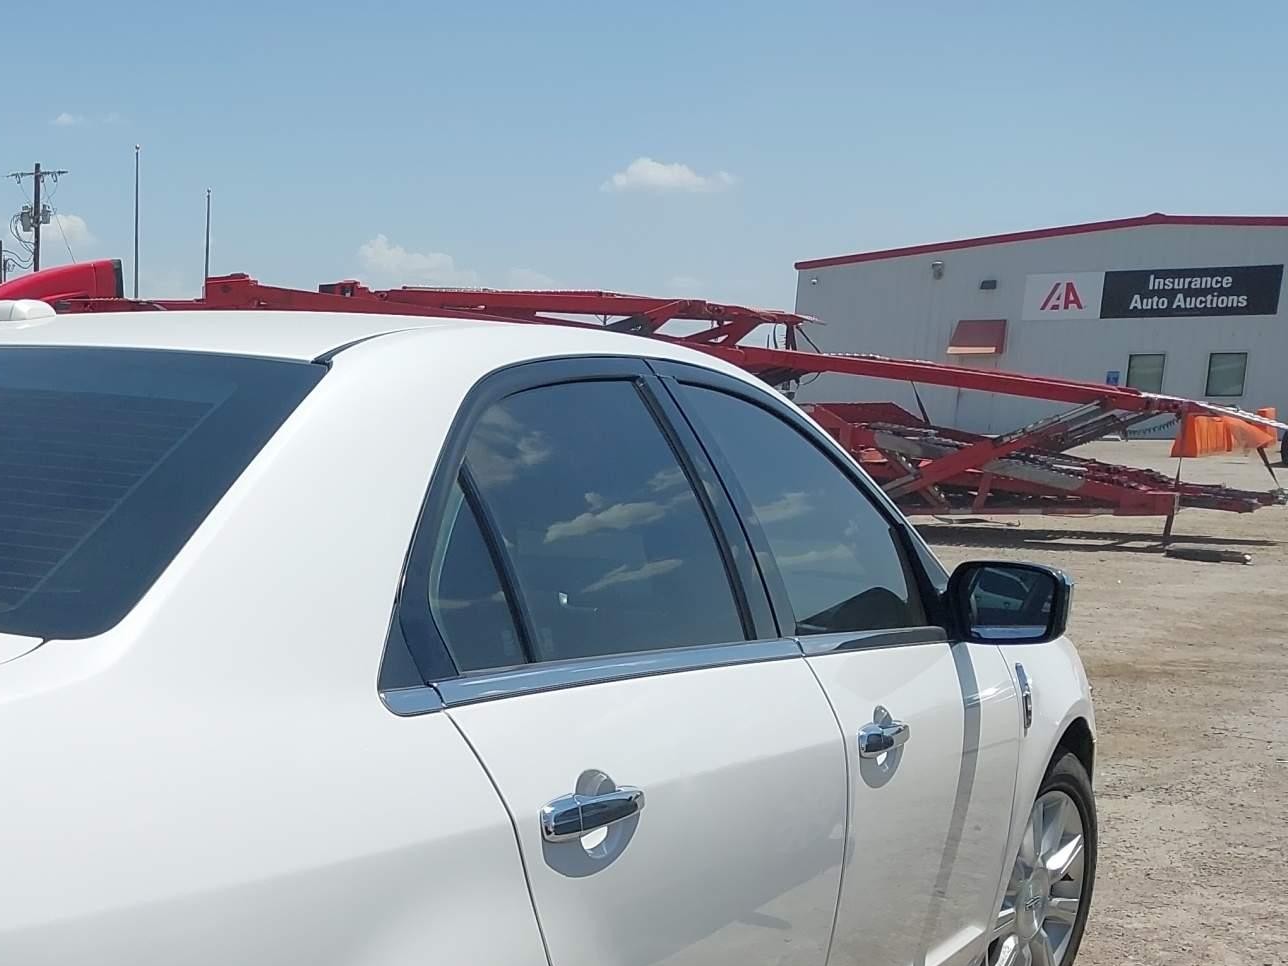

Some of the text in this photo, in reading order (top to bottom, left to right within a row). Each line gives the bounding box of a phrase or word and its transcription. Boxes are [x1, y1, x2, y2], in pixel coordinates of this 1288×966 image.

[1148, 274, 1233, 290] Insurance
[1129, 292, 1248, 310] Auto Auctions
